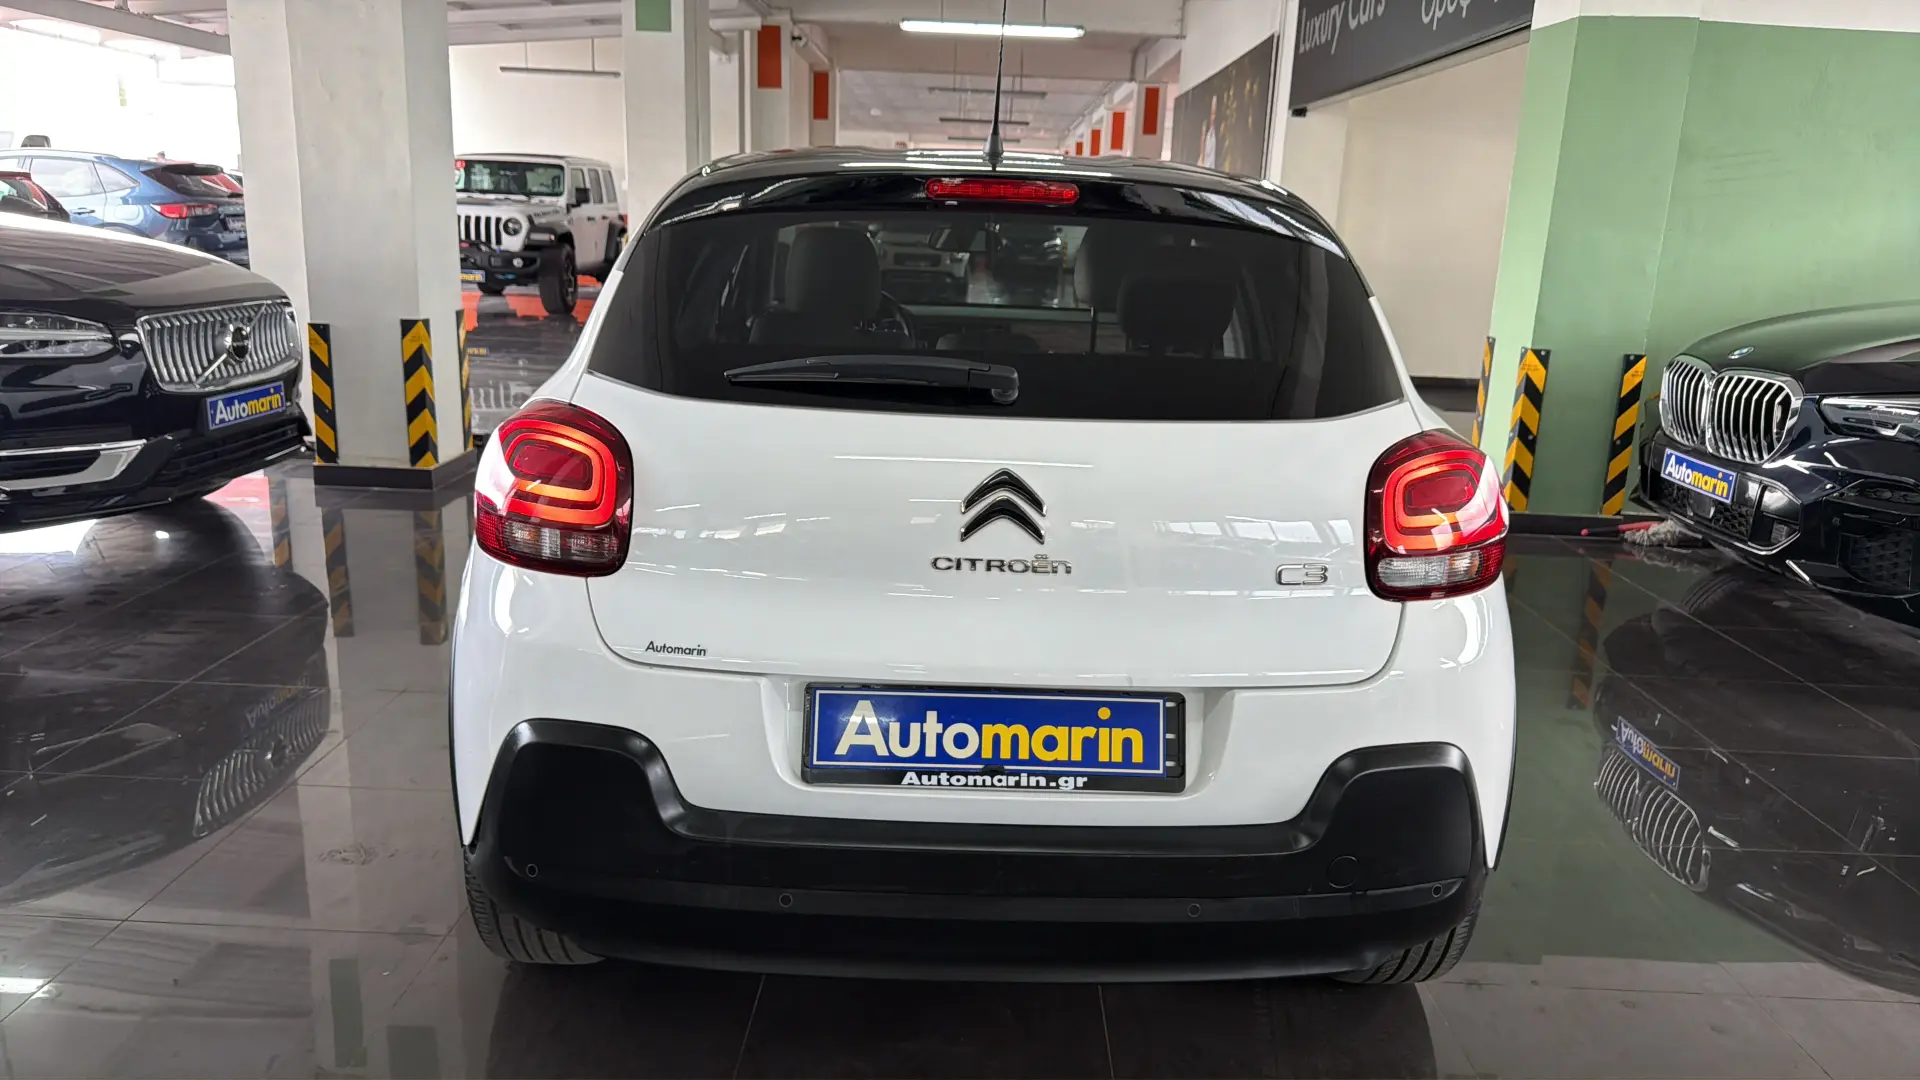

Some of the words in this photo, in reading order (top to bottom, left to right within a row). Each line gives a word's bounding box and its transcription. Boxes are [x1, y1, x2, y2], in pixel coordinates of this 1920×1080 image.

[1299, 1, 1346, 55] Luxury
[215, 387, 282, 425] Automarin
[1665, 454, 1729, 498] Automarin
[1275, 562, 1328, 585] C3
[644, 640, 707, 657] Automarin
[833, 699, 1144, 763] Automarin
[900, 771, 1088, 790] Automarin.gr
